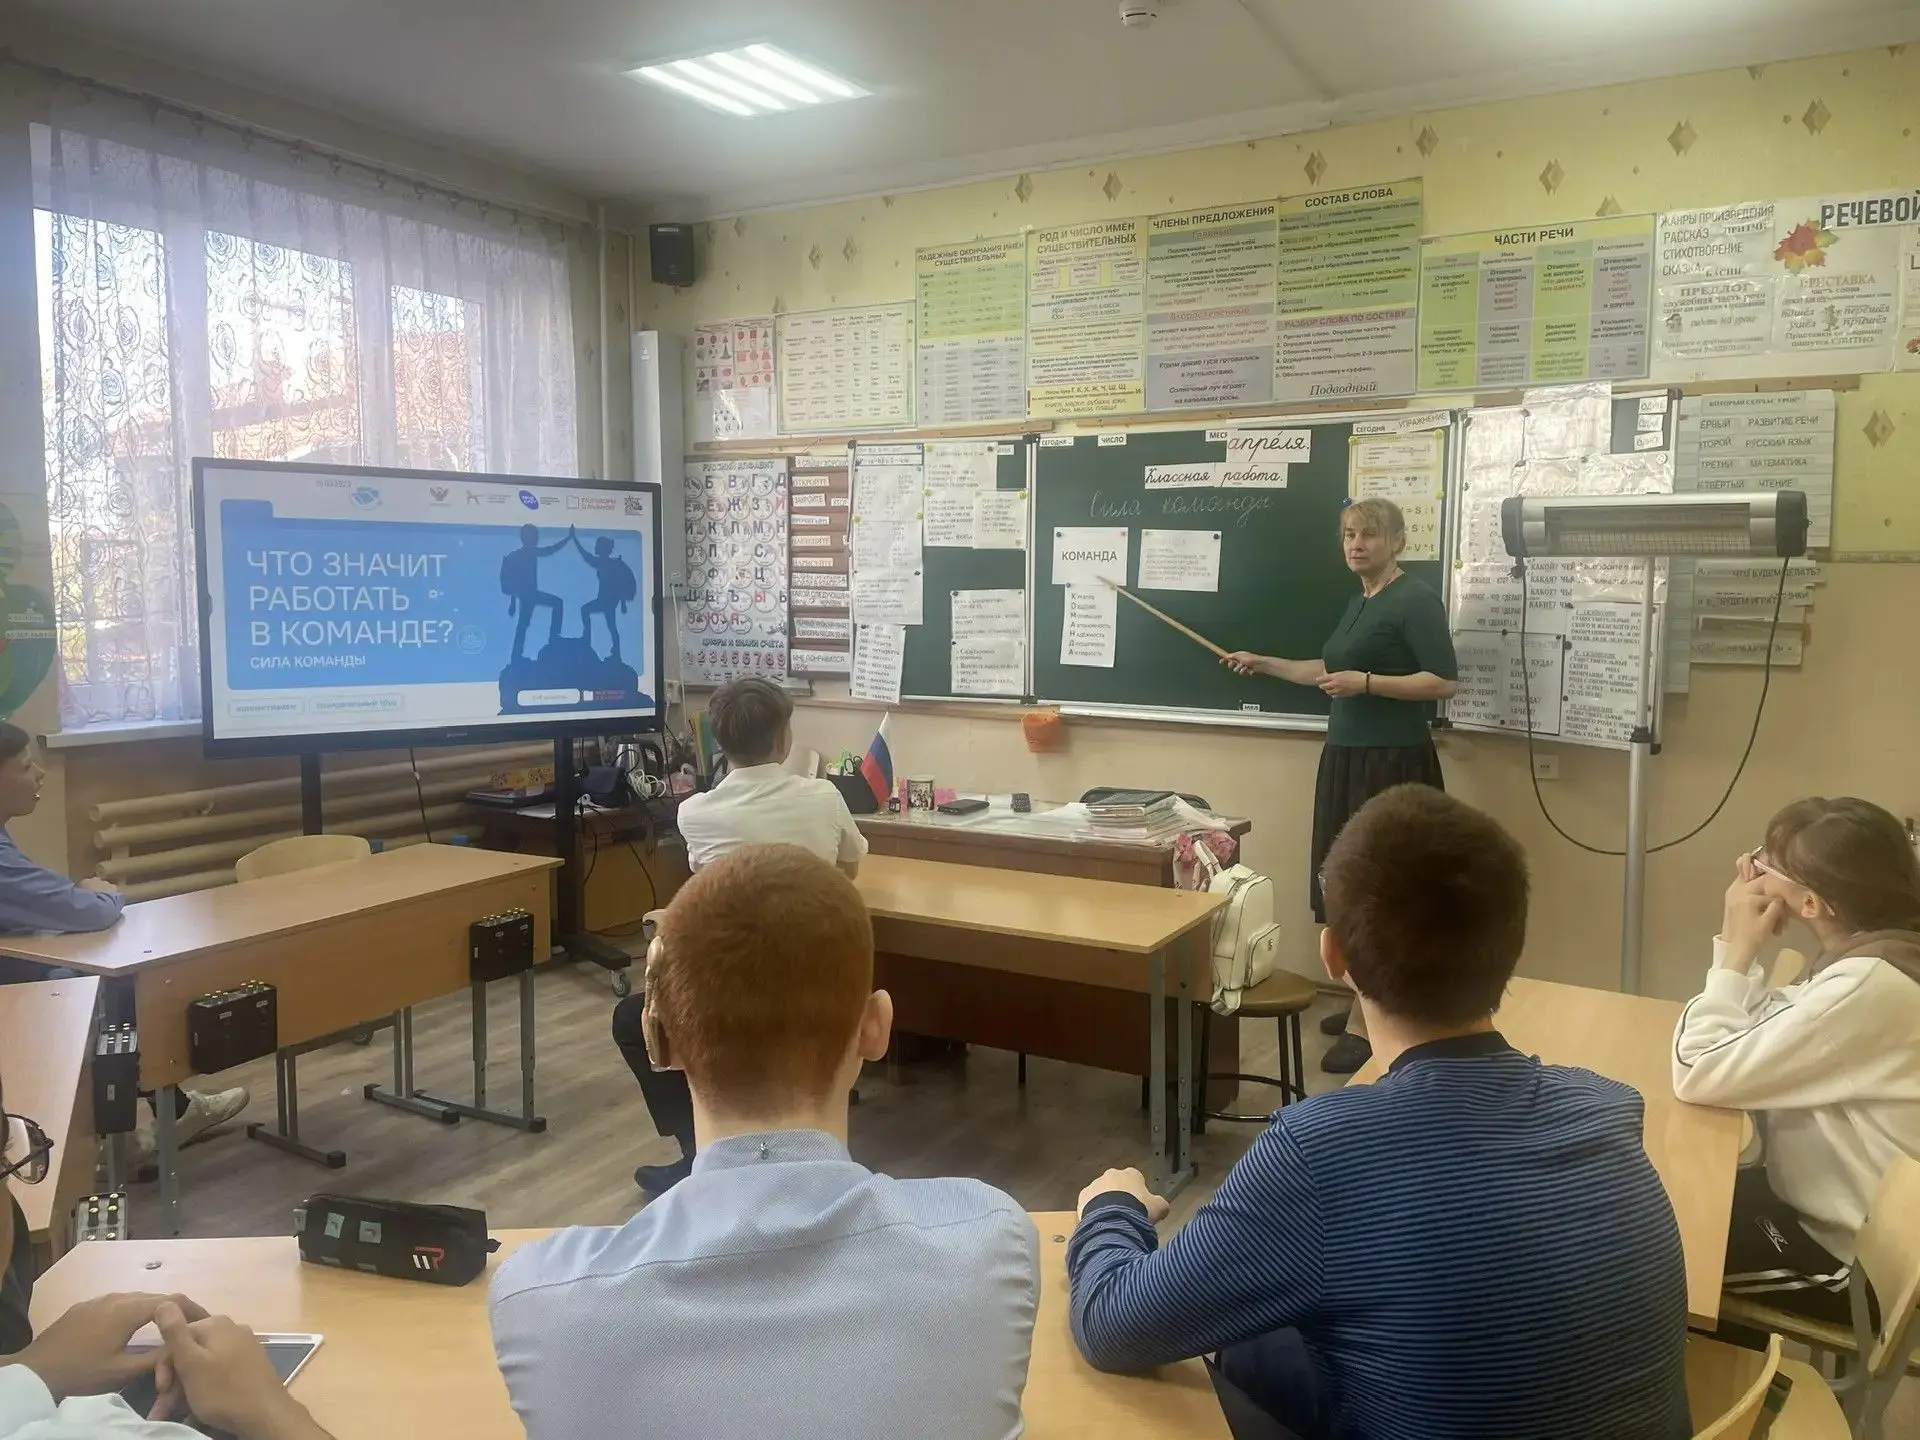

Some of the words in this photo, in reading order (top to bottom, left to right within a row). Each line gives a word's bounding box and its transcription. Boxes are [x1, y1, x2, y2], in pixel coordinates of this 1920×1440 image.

[1305, 194, 1349, 207] СОСТАВ
[1353, 188, 1393, 201] СЛОВА
[1153, 217, 1189, 228] ЧЛЕНЫ
[1192, 206, 1274, 224] ПРЕДЛОЖЕНИЯ
[1661, 213, 1696, 227] ЖАНРЫ
[1700, 204, 1775, 222] ПРОИЗВЕДЕНИЯ
[1040, 232, 1059, 242] РОД
[1070, 226, 1103, 237] ЧИСЛО
[1106, 222, 1135, 232] ИМЕН
[1494, 230, 1536, 245] ЧАСТИ
[1539, 227, 1574, 241] РЕЧИ
[1664, 228, 1709, 244] РАССКАЗ
[960, 244, 1002, 257] ОКОНЧАНИЯ
[1037, 233, 1137, 254] СУЩЕСТВИТЕЛЬНЫХ
[1663, 242, 1743, 260] СТИХОТВОРЕНИЕ
[935, 253, 1006, 266] СУЩЕСТВИТЕЛЬНЫХ
[1681, 283, 1749, 296] ПРЕДЛОГ
[1320, 316, 1349, 325] СЛОВА
[1310, 381, 1377, 396] Подводный
[1399, 413, 1447, 428] УПРАЖНЕНИЕ
[1701, 418, 1730, 429] ЕРВЫЙ
[1748, 416, 1793, 426] РАЗВИТИЕ
[1795, 415, 1819, 425] РЕЧИ
[1041, 438, 1067, 446] СЕГОДНЯ
[1745, 438, 1785, 448] РУССКИЙ
[1787, 437, 1812, 446] ЯЗЫК
[1701, 459, 1734, 469] ТРЕТИЙ
[1750, 458, 1807, 468] МАТЕМАТИКА
[705, 475, 713, 489] Б
[728, 475, 737, 488] В
[752, 473, 759, 487] Г
[775, 472, 786, 488] Д
[1145, 468, 1210, 484] Классная
[1221, 465, 1283, 487] работа.
[1759, 479, 1793, 488] ЧТЕНИЕ
[728, 497, 741, 511] Ж
[752, 497, 760, 510] З
[1090, 490, 1141, 518] Сила
[708, 521, 717, 534] К
[731, 520, 740, 534] Л
[753, 520, 763, 533] М
[776, 520, 785, 533] Н
[709, 544, 717, 557] П
[754, 543, 763, 557] С
[1062, 551, 1118, 563] КОМАНДА
[247, 550, 312, 576] ЧТО
[323, 551, 447, 577] ЗНАЧИТ
[708, 567, 718, 579] Ф
[755, 567, 765, 582] Ц
[1753, 569, 1781, 578] БУДЕМ
[250, 585, 410, 612] РАБОТАТЬ
[754, 589, 766, 602] Ы
[251, 620, 271, 646] В
[281, 619, 453, 648] КОМАНДЕ?
[251, 656, 291, 669] СИЛА
[294, 655, 366, 669] КОМАНДЫ
